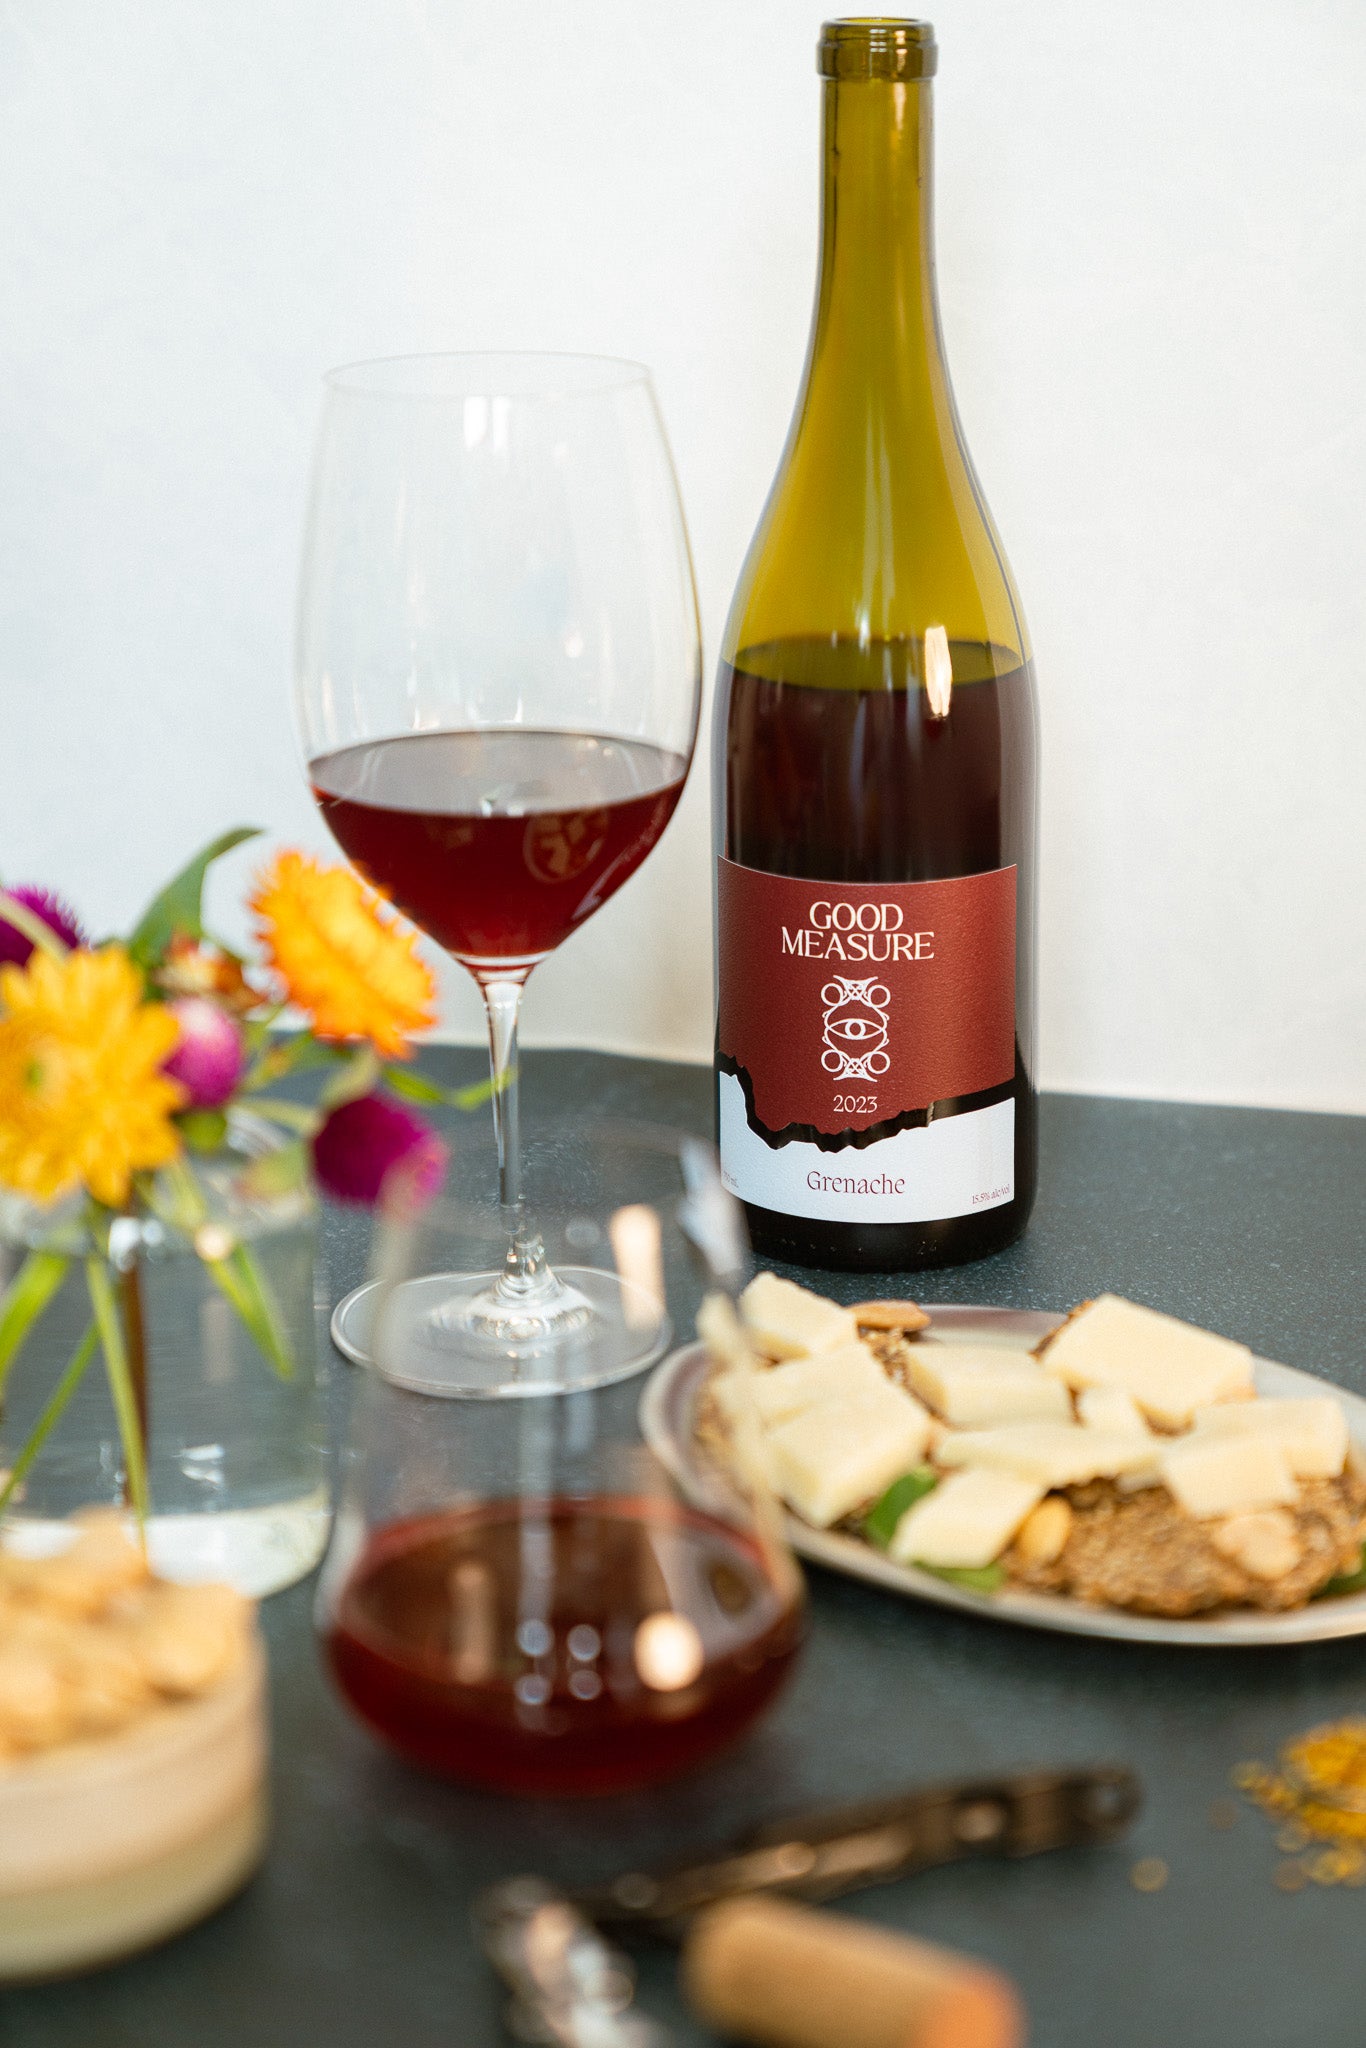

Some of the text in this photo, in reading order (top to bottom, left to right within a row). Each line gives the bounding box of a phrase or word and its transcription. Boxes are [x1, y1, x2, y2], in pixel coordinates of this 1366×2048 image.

[809, 901, 904, 932] GOOD
[781, 926, 935, 962] MEASURE
[833, 1094, 878, 1113] 2023
[807, 1171, 905, 1194] Grenache
